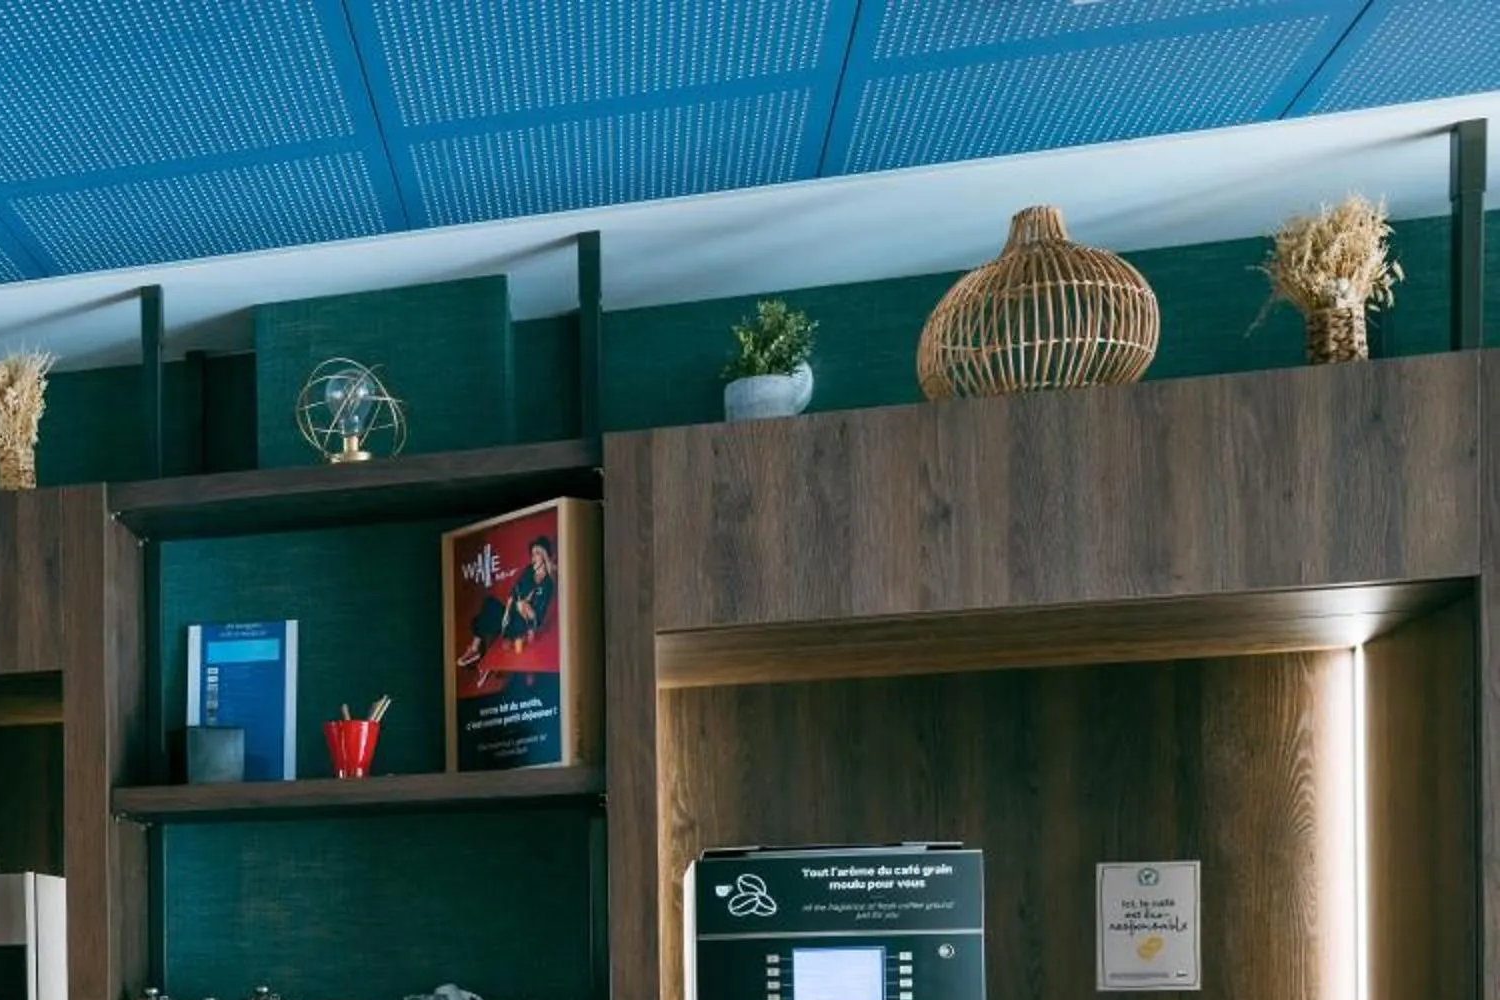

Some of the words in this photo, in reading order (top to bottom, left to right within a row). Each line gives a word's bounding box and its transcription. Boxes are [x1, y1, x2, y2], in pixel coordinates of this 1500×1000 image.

[801, 867, 829, 877] Tout
[831, 866, 875, 877] l'arôme
[877, 865, 892, 875] du
[894, 864, 921, 875] café
[922, 863, 953, 877] grain
[829, 880, 866, 890] moulu
[867, 880, 895, 891] pour
[897, 879, 926, 889] vous
